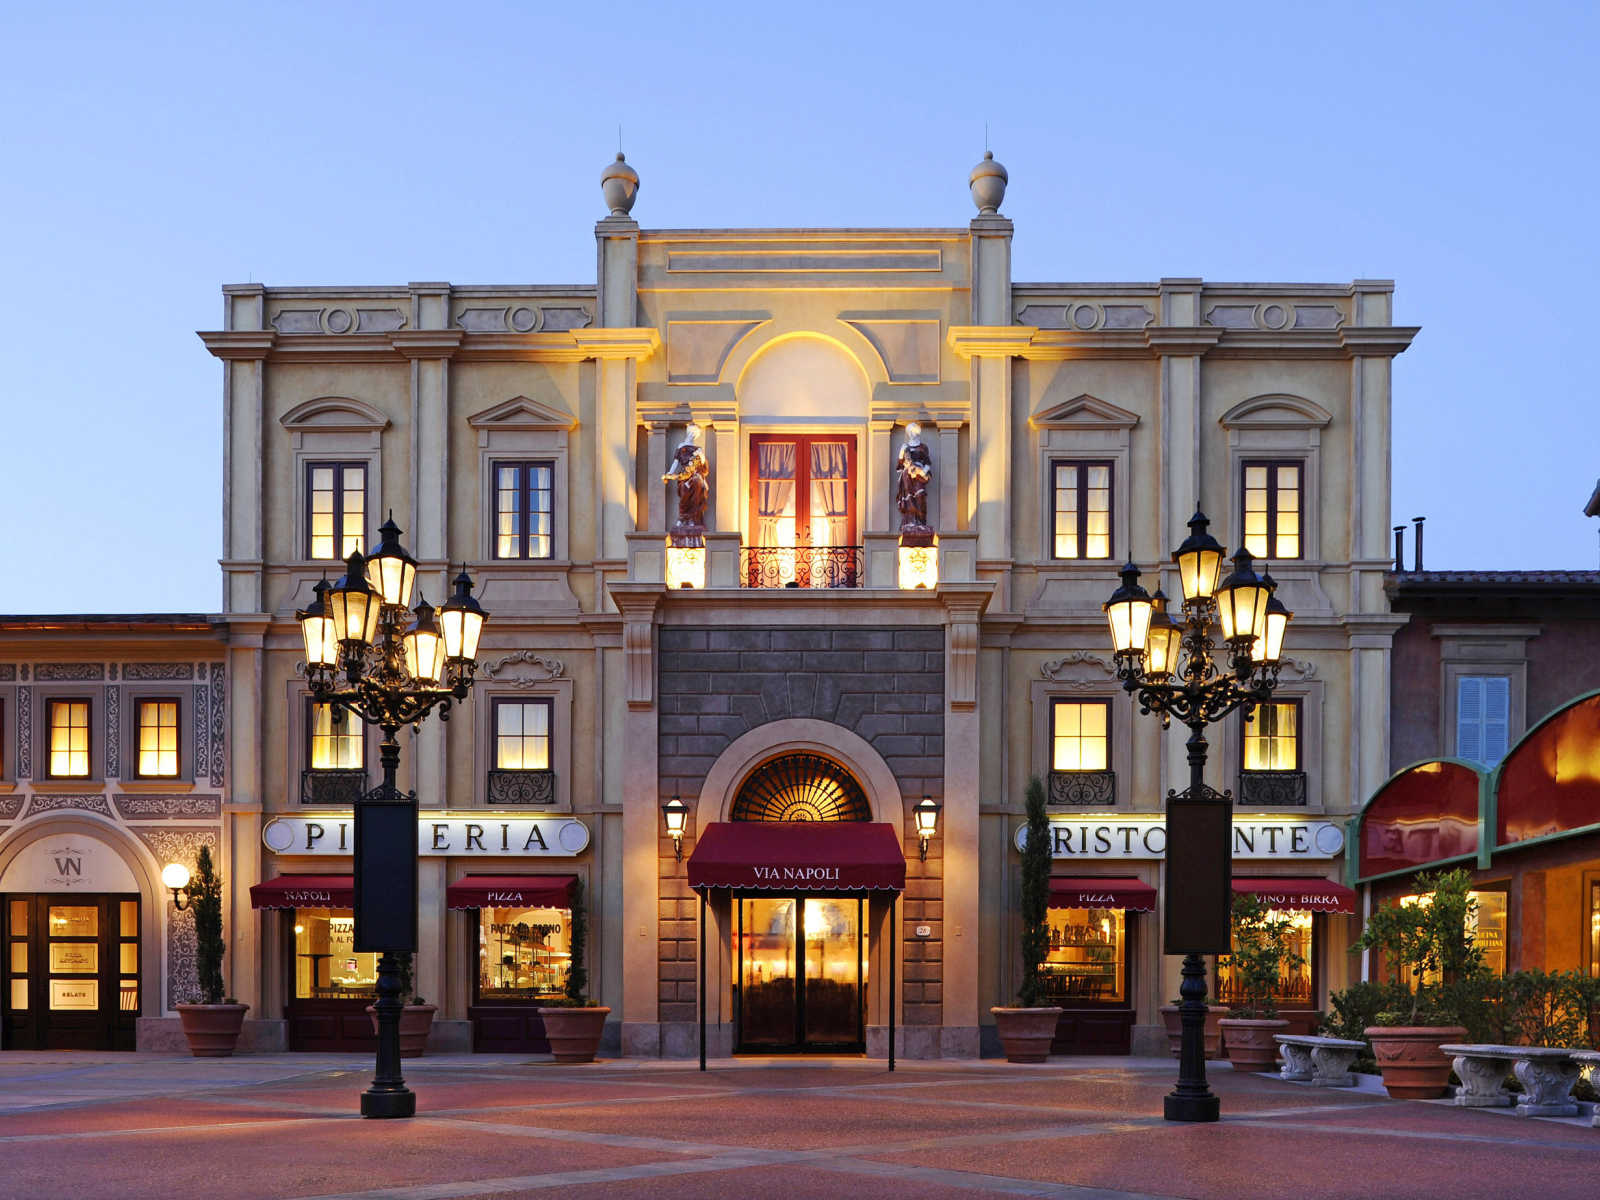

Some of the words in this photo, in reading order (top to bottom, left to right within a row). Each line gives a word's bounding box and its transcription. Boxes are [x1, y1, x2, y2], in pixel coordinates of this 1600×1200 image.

[305, 823, 549, 850] PIERIA
[1053, 826, 1309, 853] RISTONTE
[753, 867, 780, 879] VIA
[783, 867, 840, 880] NAPOLI
[284, 891, 331, 901] NAPOLI
[488, 891, 523, 901] PIZZA
[1079, 894, 1115, 902] PIZZA
[1255, 894, 1286, 904] VINO
[1290, 895, 1296, 904] E
[1301, 895, 1339, 905] BIRRA
[329, 923, 354, 934] PIZZA
[1472, 939, 1503, 947] POLETANA
